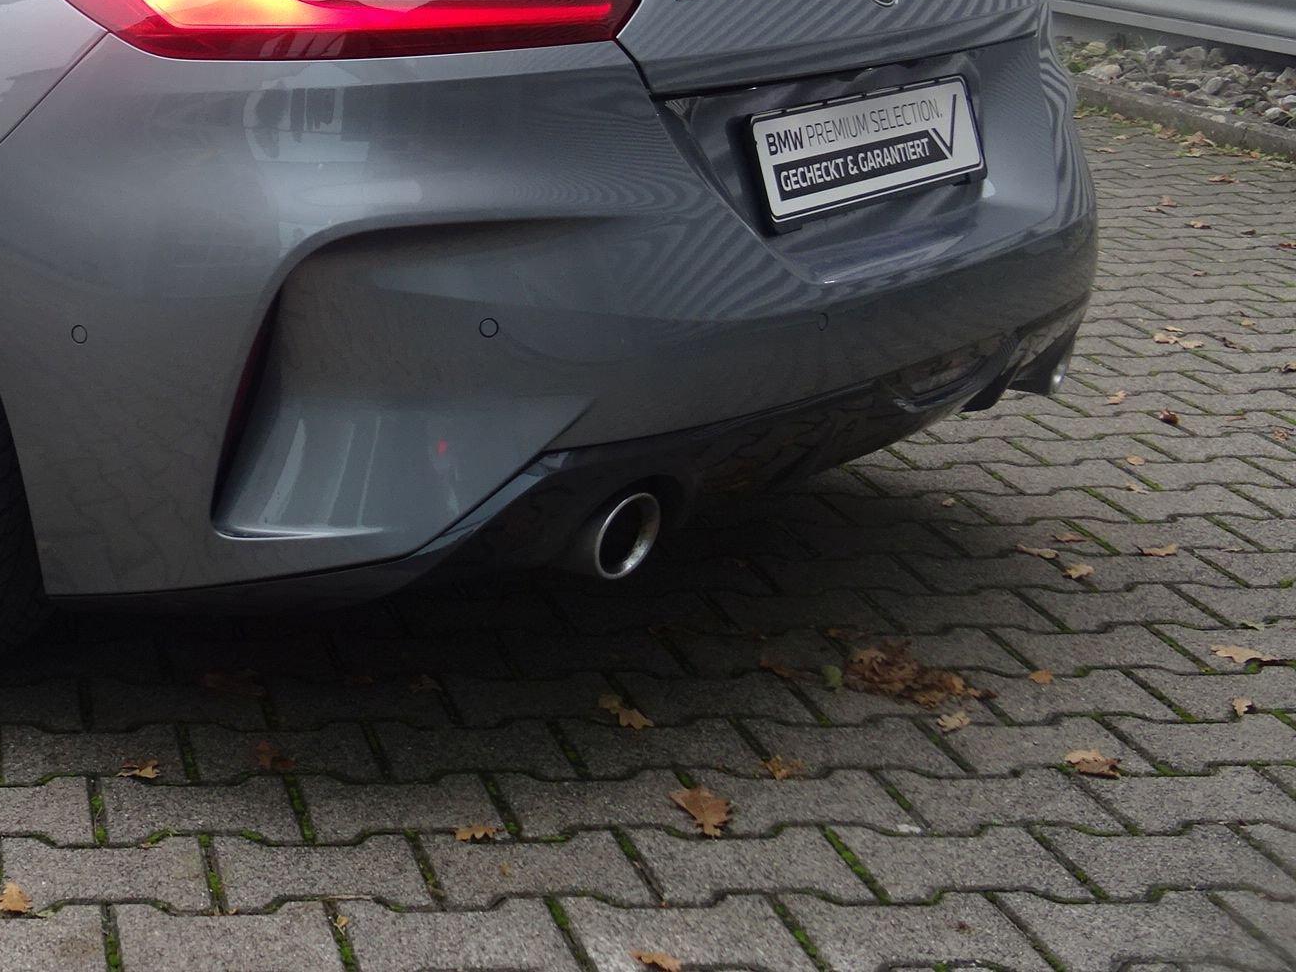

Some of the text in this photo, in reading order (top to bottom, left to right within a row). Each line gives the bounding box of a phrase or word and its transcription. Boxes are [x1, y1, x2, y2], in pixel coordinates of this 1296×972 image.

[766, 127, 804, 156] BMW
[806, 114, 869, 147] PREMIUM
[780, 138, 930, 192] GECHECKT & GARANTIERT
